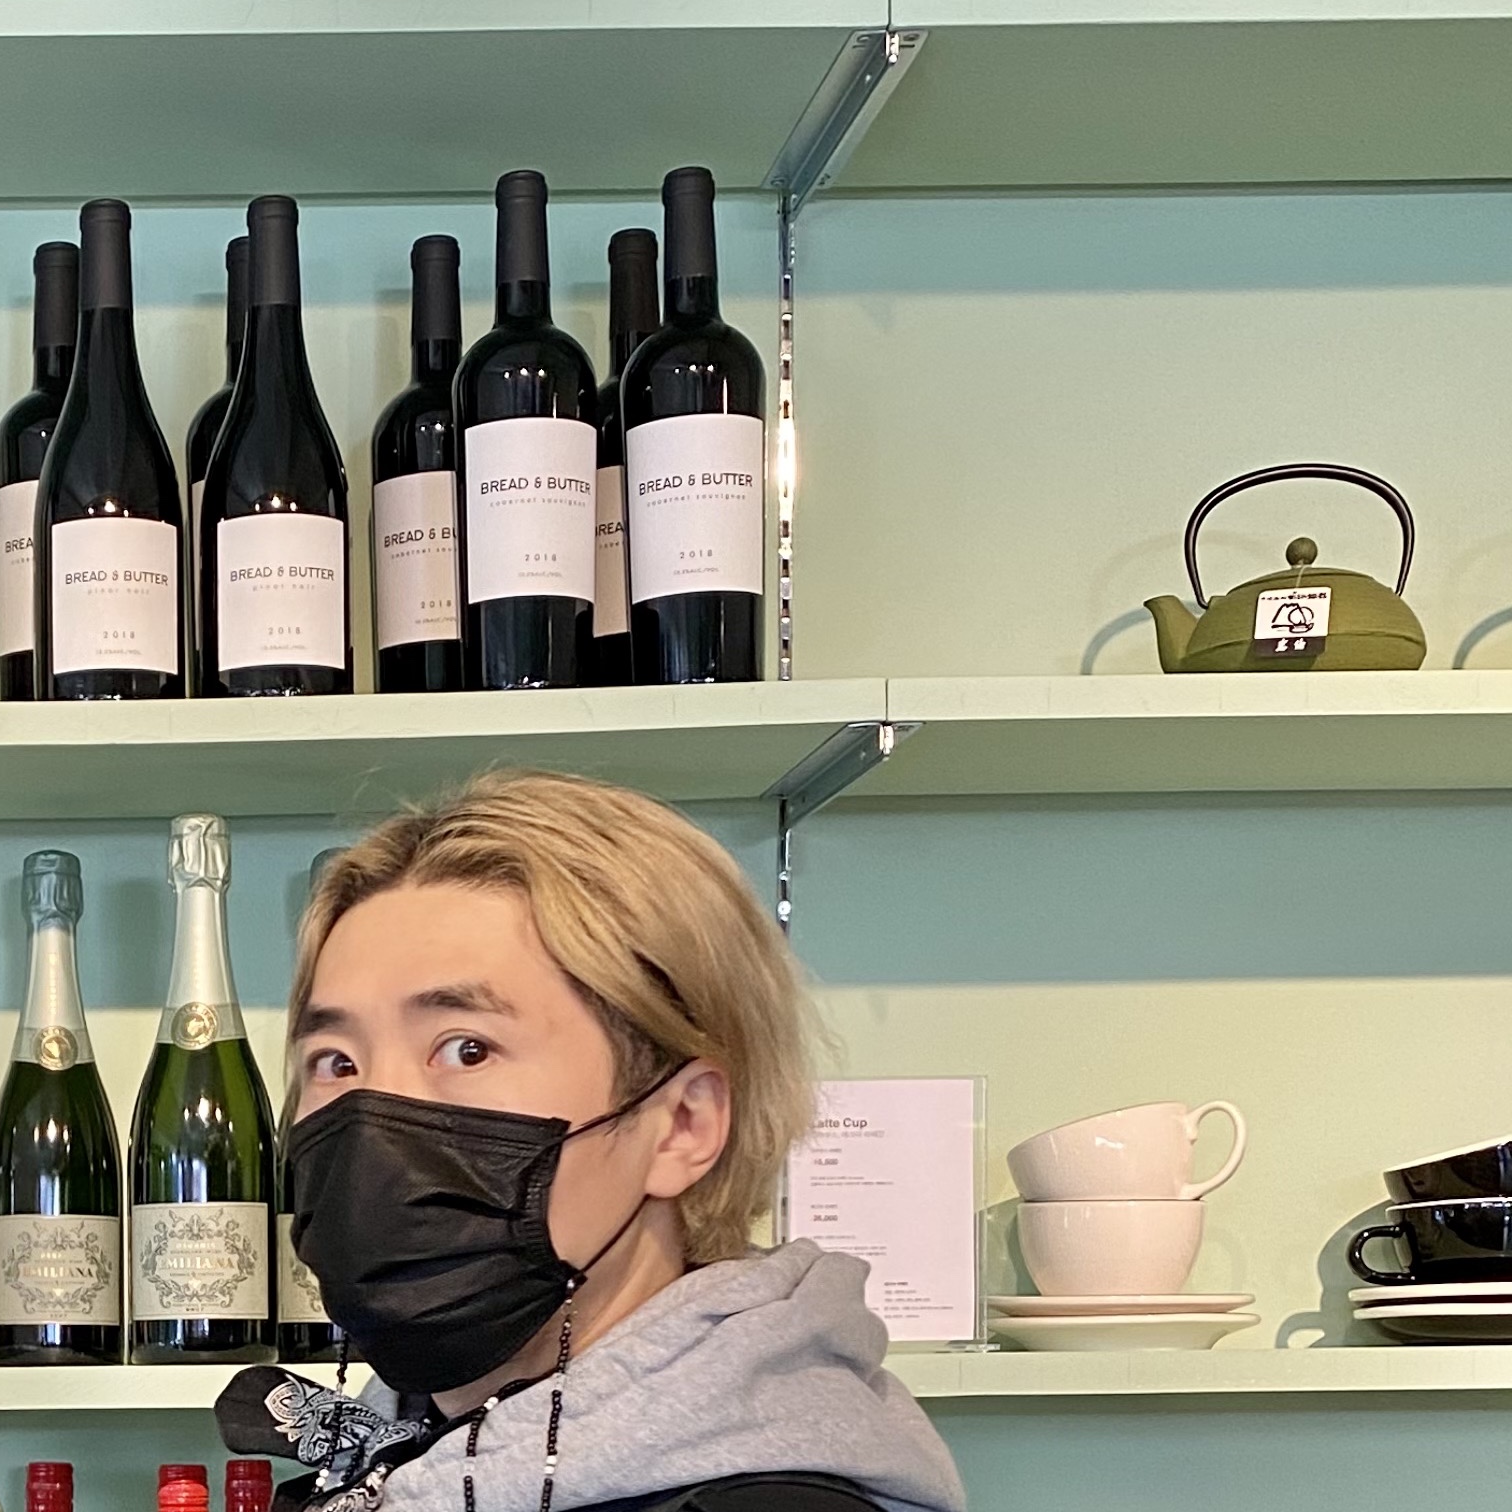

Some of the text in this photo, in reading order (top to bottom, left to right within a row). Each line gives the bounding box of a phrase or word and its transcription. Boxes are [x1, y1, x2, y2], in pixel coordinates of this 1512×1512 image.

[481, 476, 591, 495] BREAD & BUTTER
[639, 472, 753, 496] BREAD & BUTTER
[5, 536, 33, 553] BREA
[383, 529, 424, 548] BREAD
[428, 528, 436, 540] &
[65, 570, 107, 584] BREAD
[123, 570, 168, 586] BUTTER
[230, 566, 335, 582] BREAD & BUTTER
[843, 1117, 868, 1129] Cup
